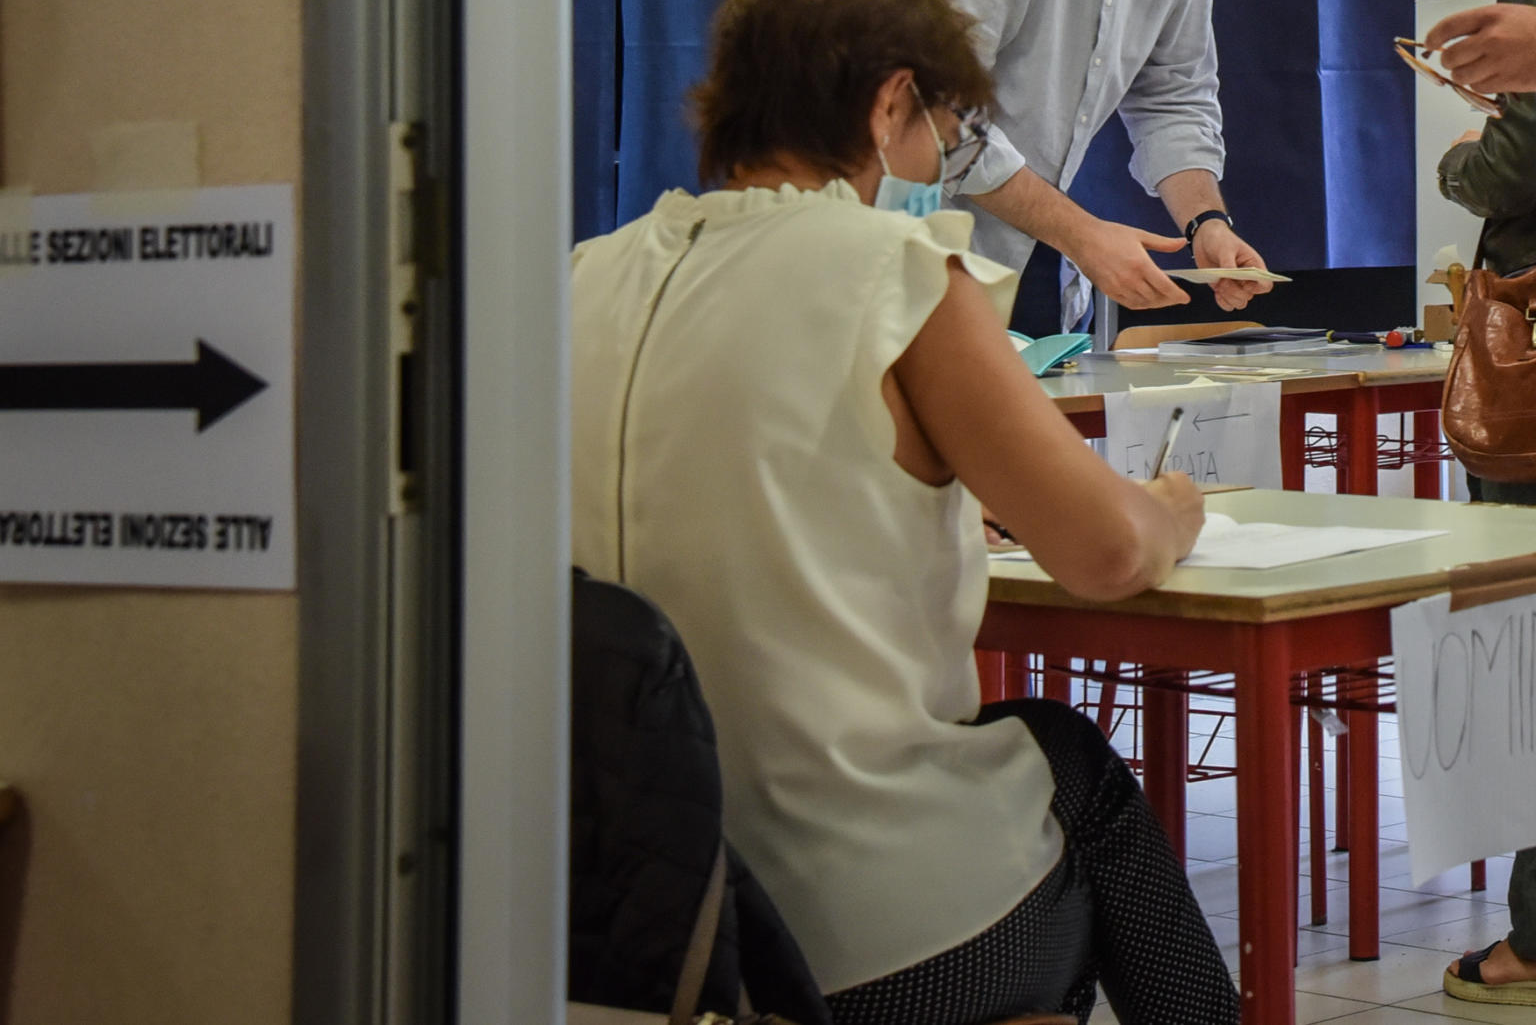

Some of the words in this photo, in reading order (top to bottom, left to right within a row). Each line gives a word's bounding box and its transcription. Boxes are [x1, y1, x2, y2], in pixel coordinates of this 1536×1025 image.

[45, 226, 134, 265] SEZIONI
[137, 222, 273, 262] ELETTORALI
[119, 513, 209, 551] SEZIONI
[213, 514, 273, 552] ALLE
